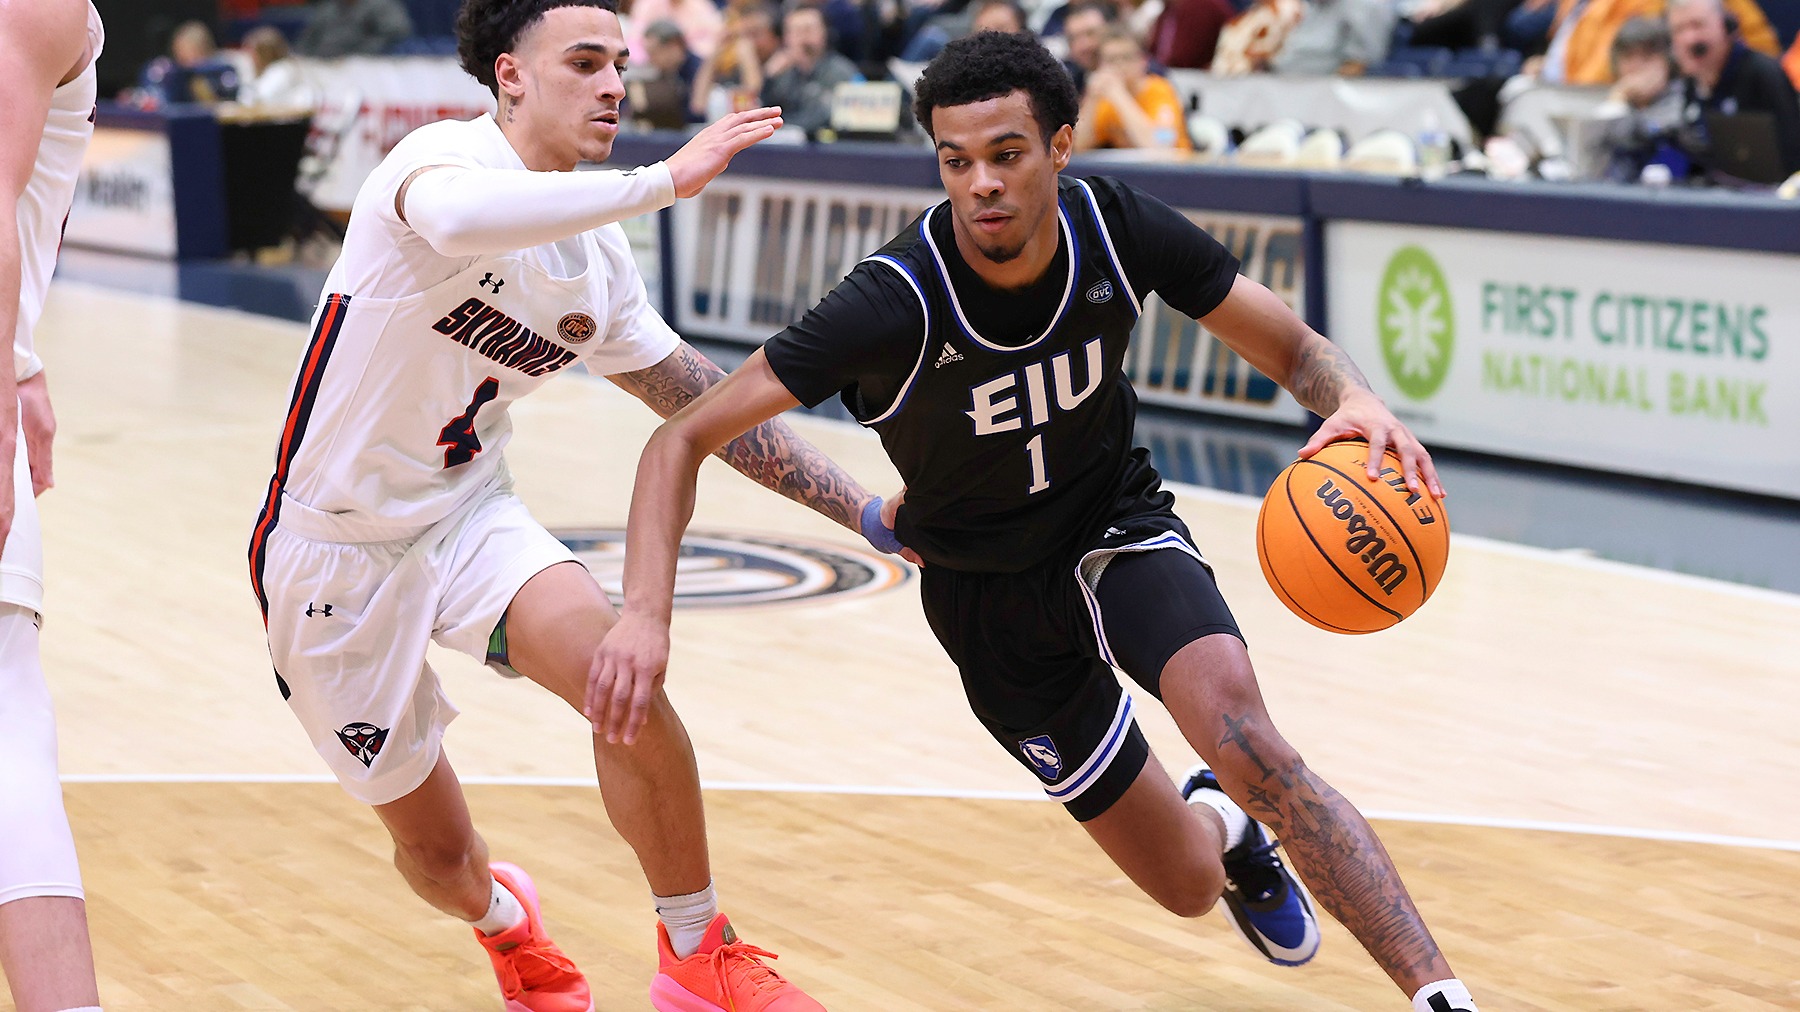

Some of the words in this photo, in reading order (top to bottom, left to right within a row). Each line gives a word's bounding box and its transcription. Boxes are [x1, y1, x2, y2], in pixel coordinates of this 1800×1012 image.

[432, 297, 578, 377] SKYHAWKS
[934, 353, 964, 369] adidas
[1481, 281, 1577, 341] FIRST
[1590, 290, 1770, 362] CITIZENS
[436, 376, 499, 469] 4
[961, 335, 1104, 437] EIU
[1481, 345, 1655, 413] NATIONAL
[1668, 368, 1769, 428] BANK
[1024, 432, 1051, 495] 1
[1316, 478, 1408, 597] Wilson
